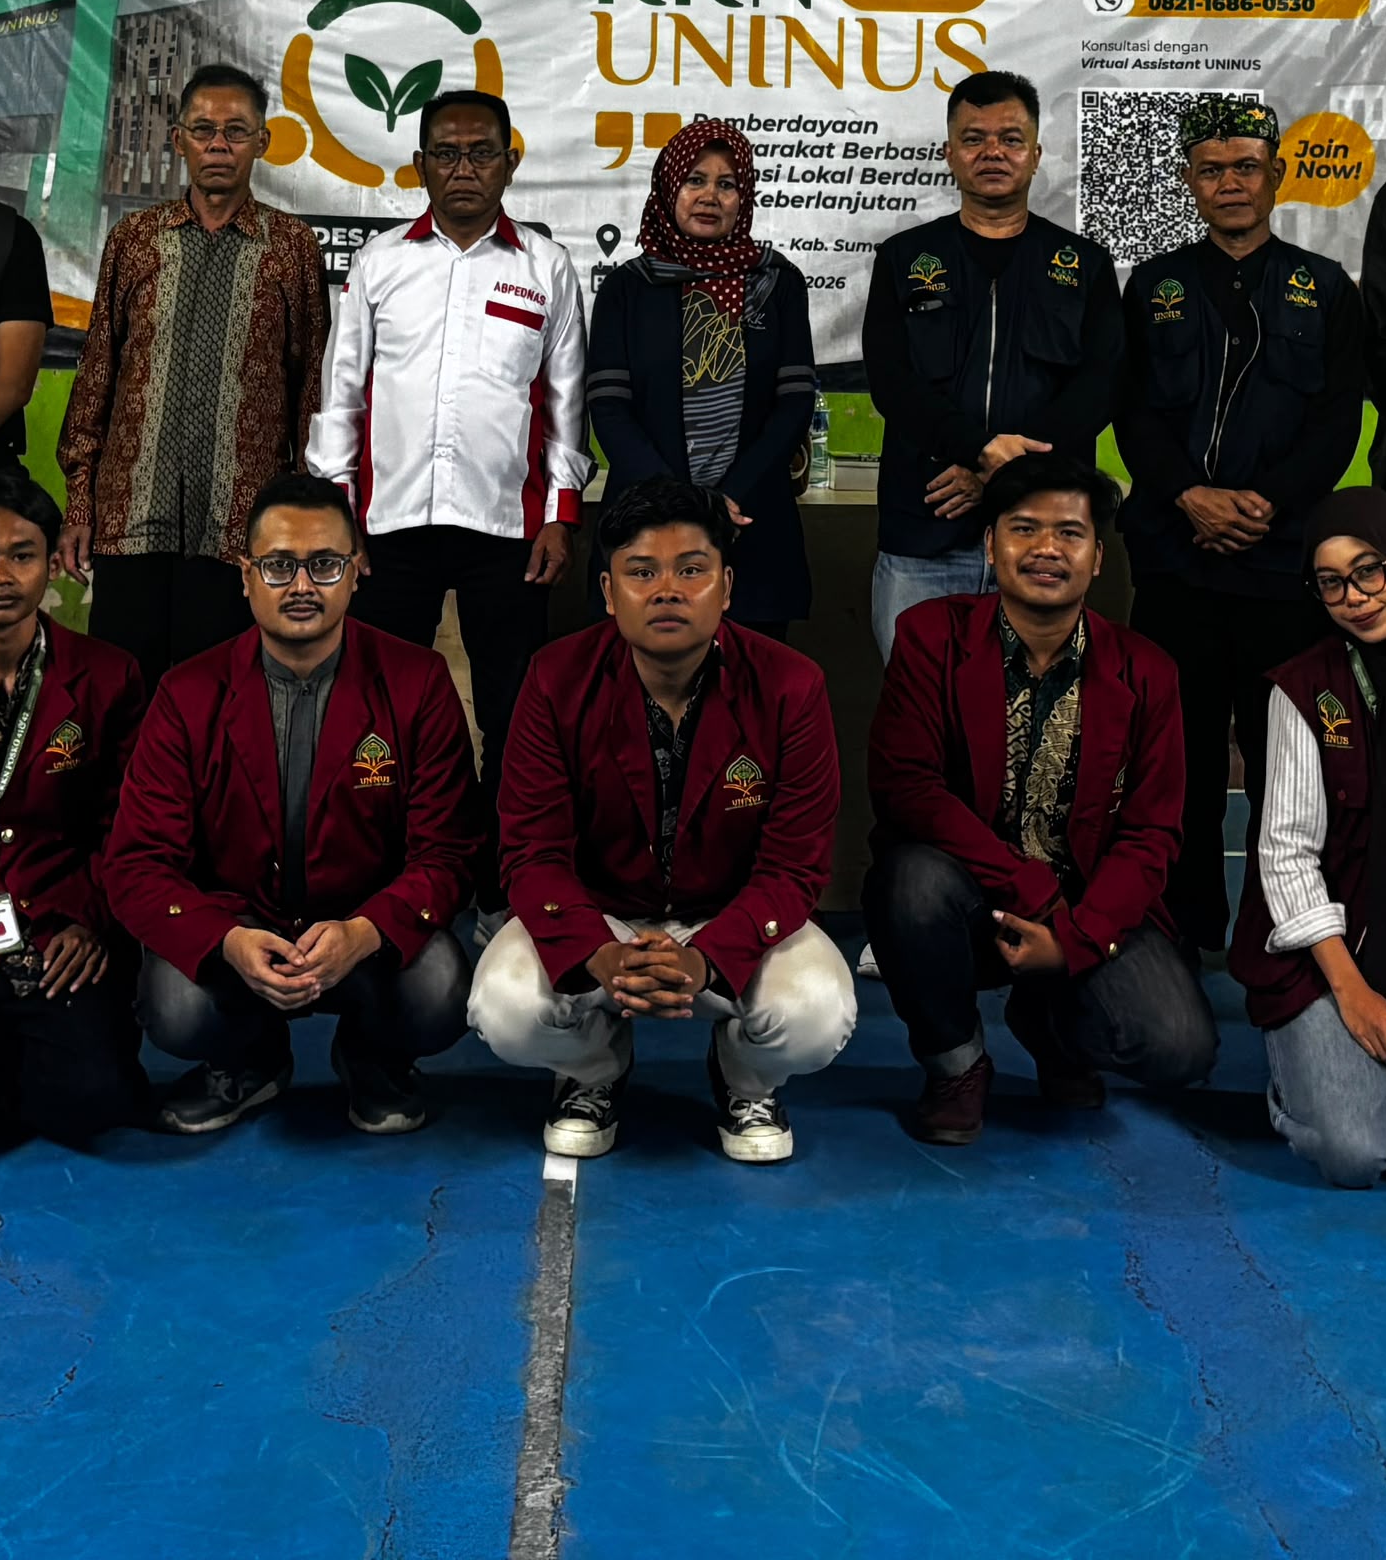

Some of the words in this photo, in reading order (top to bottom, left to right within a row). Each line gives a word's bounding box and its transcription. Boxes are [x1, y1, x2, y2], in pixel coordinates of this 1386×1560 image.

[590, 11, 988, 94] UNINUS
[1082, 40, 1150, 52] Konsultasi
[1154, 40, 1208, 56] dengan
[1081, 58, 1128, 70] Virtual
[1132, 58, 1201, 70] Assistant
[1205, 60, 1262, 71] UNINUS
[842, 142, 946, 161] Berbasis
[1294, 139, 1349, 159] Join
[787, 165, 854, 184] Lokal
[1296, 160, 1362, 180] Now!
[790, 238, 828, 251] Kab.
[494, 281, 547, 306] ABPEDNAS
